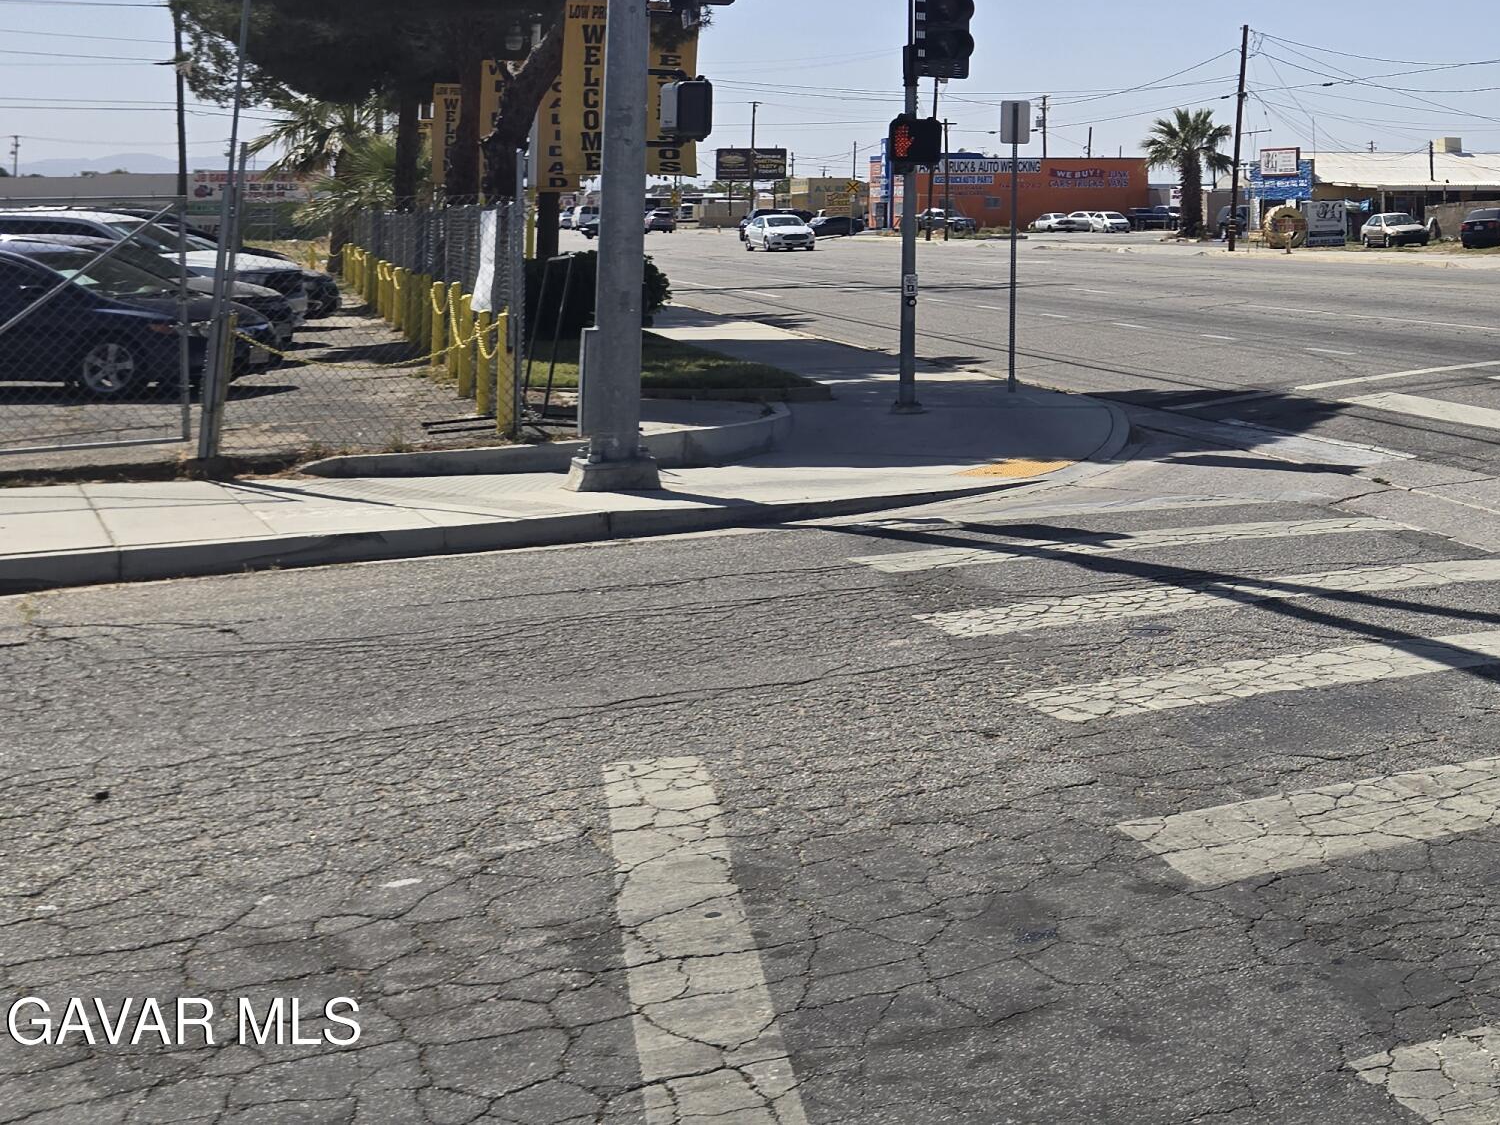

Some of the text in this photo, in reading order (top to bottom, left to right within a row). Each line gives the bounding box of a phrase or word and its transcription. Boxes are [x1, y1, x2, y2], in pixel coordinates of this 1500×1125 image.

[569, 5, 588, 19] LOW
[581, 24, 606, 171] WELCOME
[945, 161, 969, 172] RUCK
[977, 161, 999, 172] AUTO
[1000, 161, 1041, 172] WRCKING
[1056, 170, 1072, 179] WE
